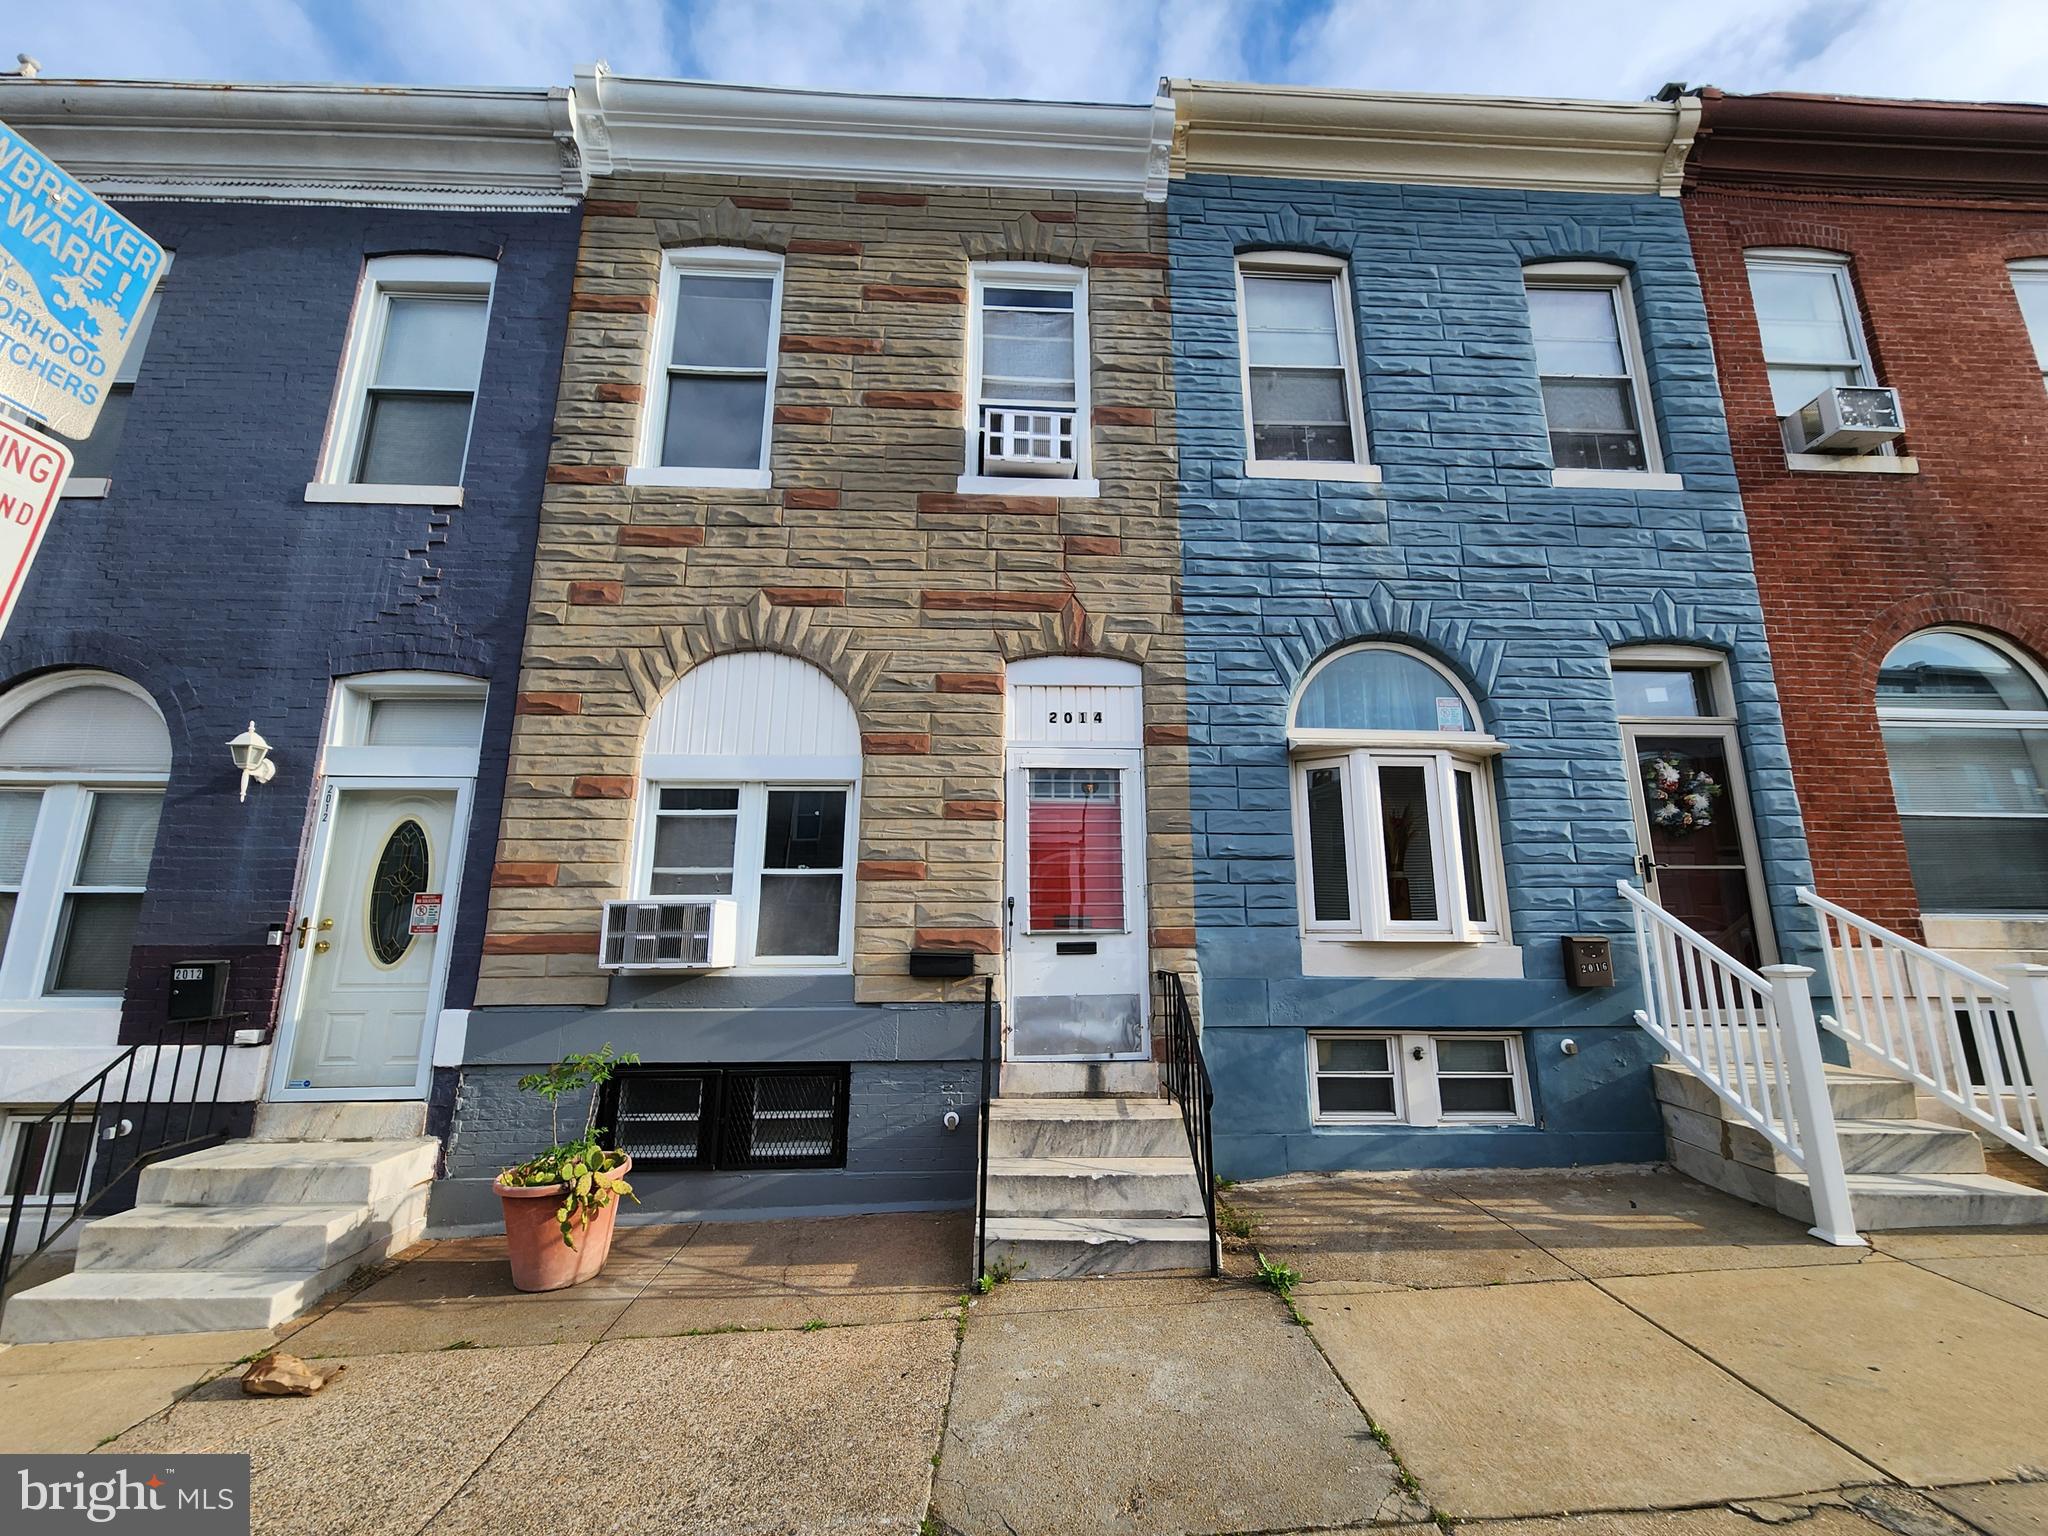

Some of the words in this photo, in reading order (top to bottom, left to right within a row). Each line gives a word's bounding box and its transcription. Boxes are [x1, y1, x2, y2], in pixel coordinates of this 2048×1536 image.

[1049, 712, 1103, 724] 2014
[322, 784, 334, 822] 2012
[1581, 962, 1608, 974] 2016
[175, 969, 203, 980] 2012
